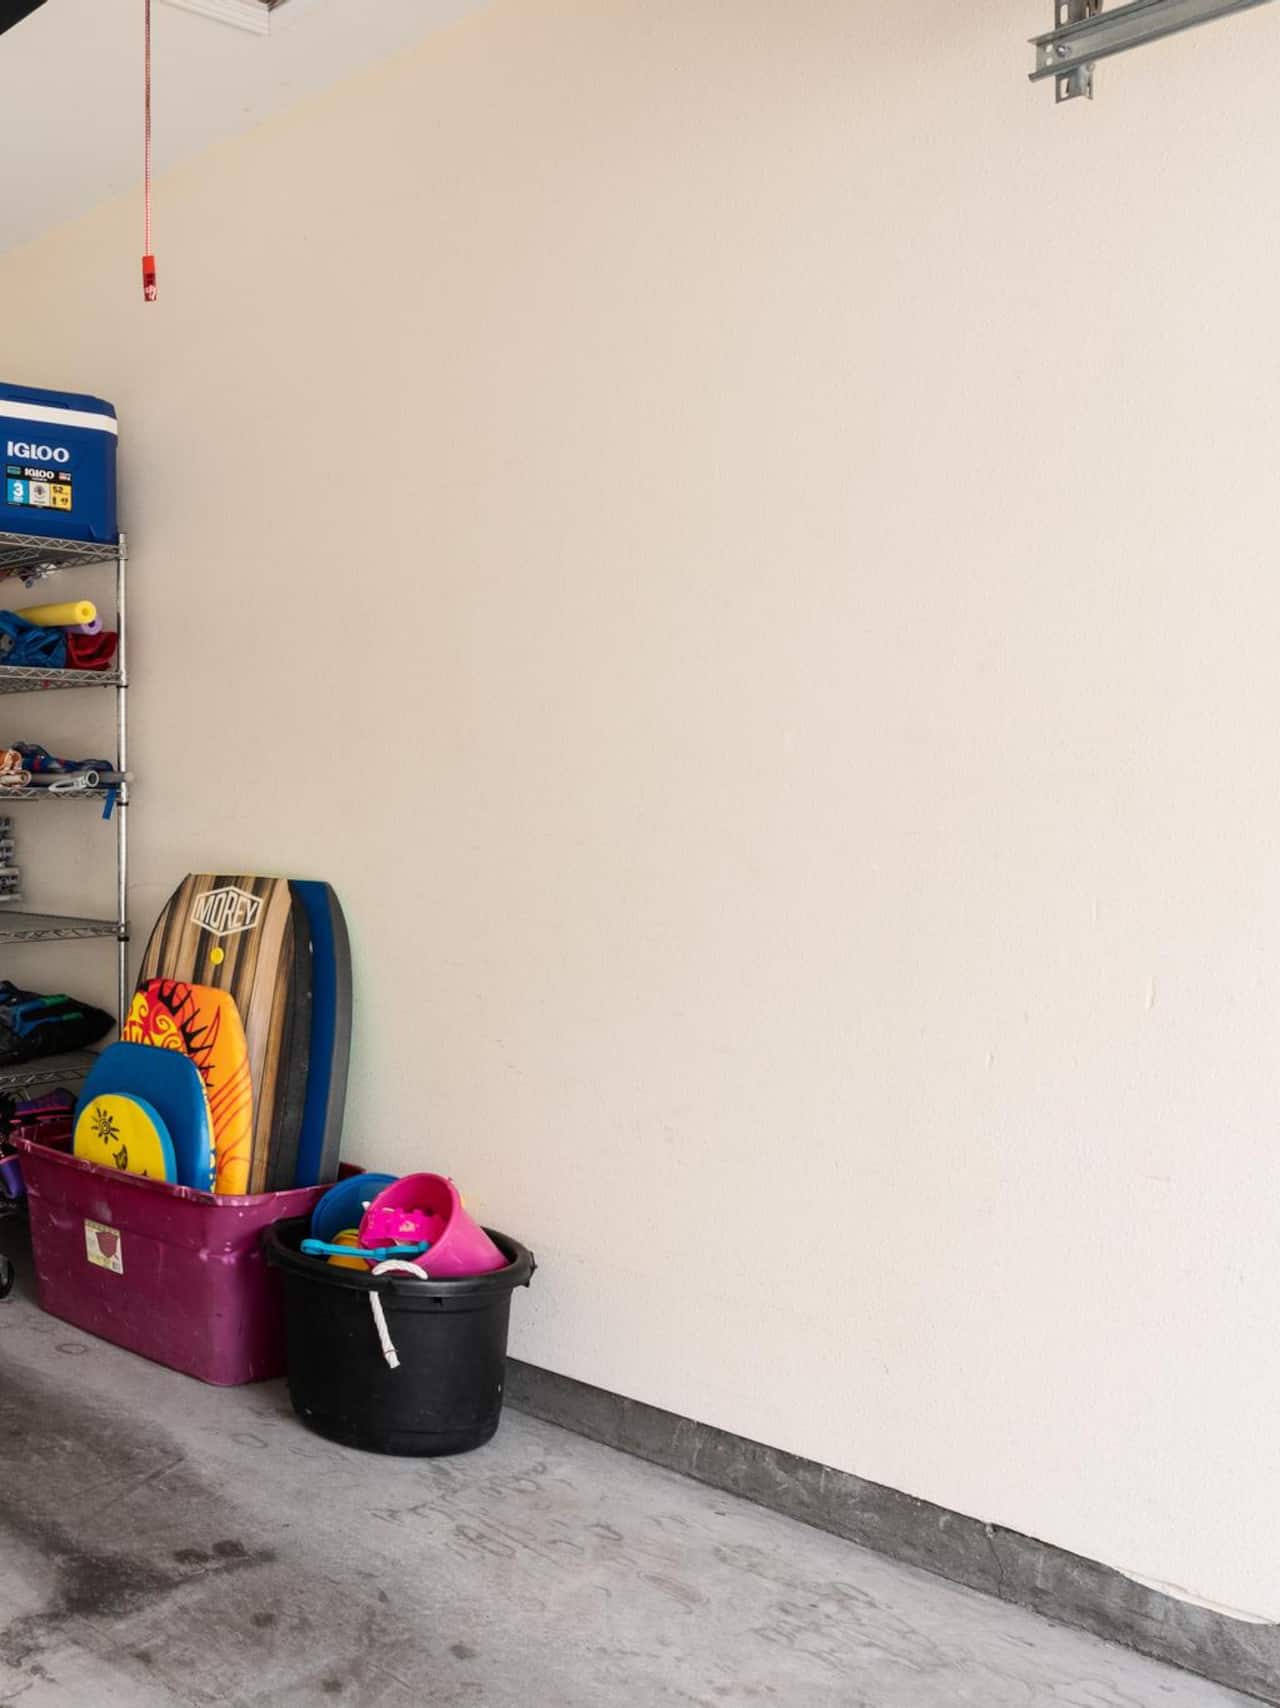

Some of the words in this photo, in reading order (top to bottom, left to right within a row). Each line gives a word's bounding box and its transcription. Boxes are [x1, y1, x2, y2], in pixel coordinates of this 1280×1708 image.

[7, 441, 70, 463] IGLOO
[24, 468, 55, 479] IGLOO
[13, 483, 24, 497] 3
[195, 890, 258, 932] MOREY
